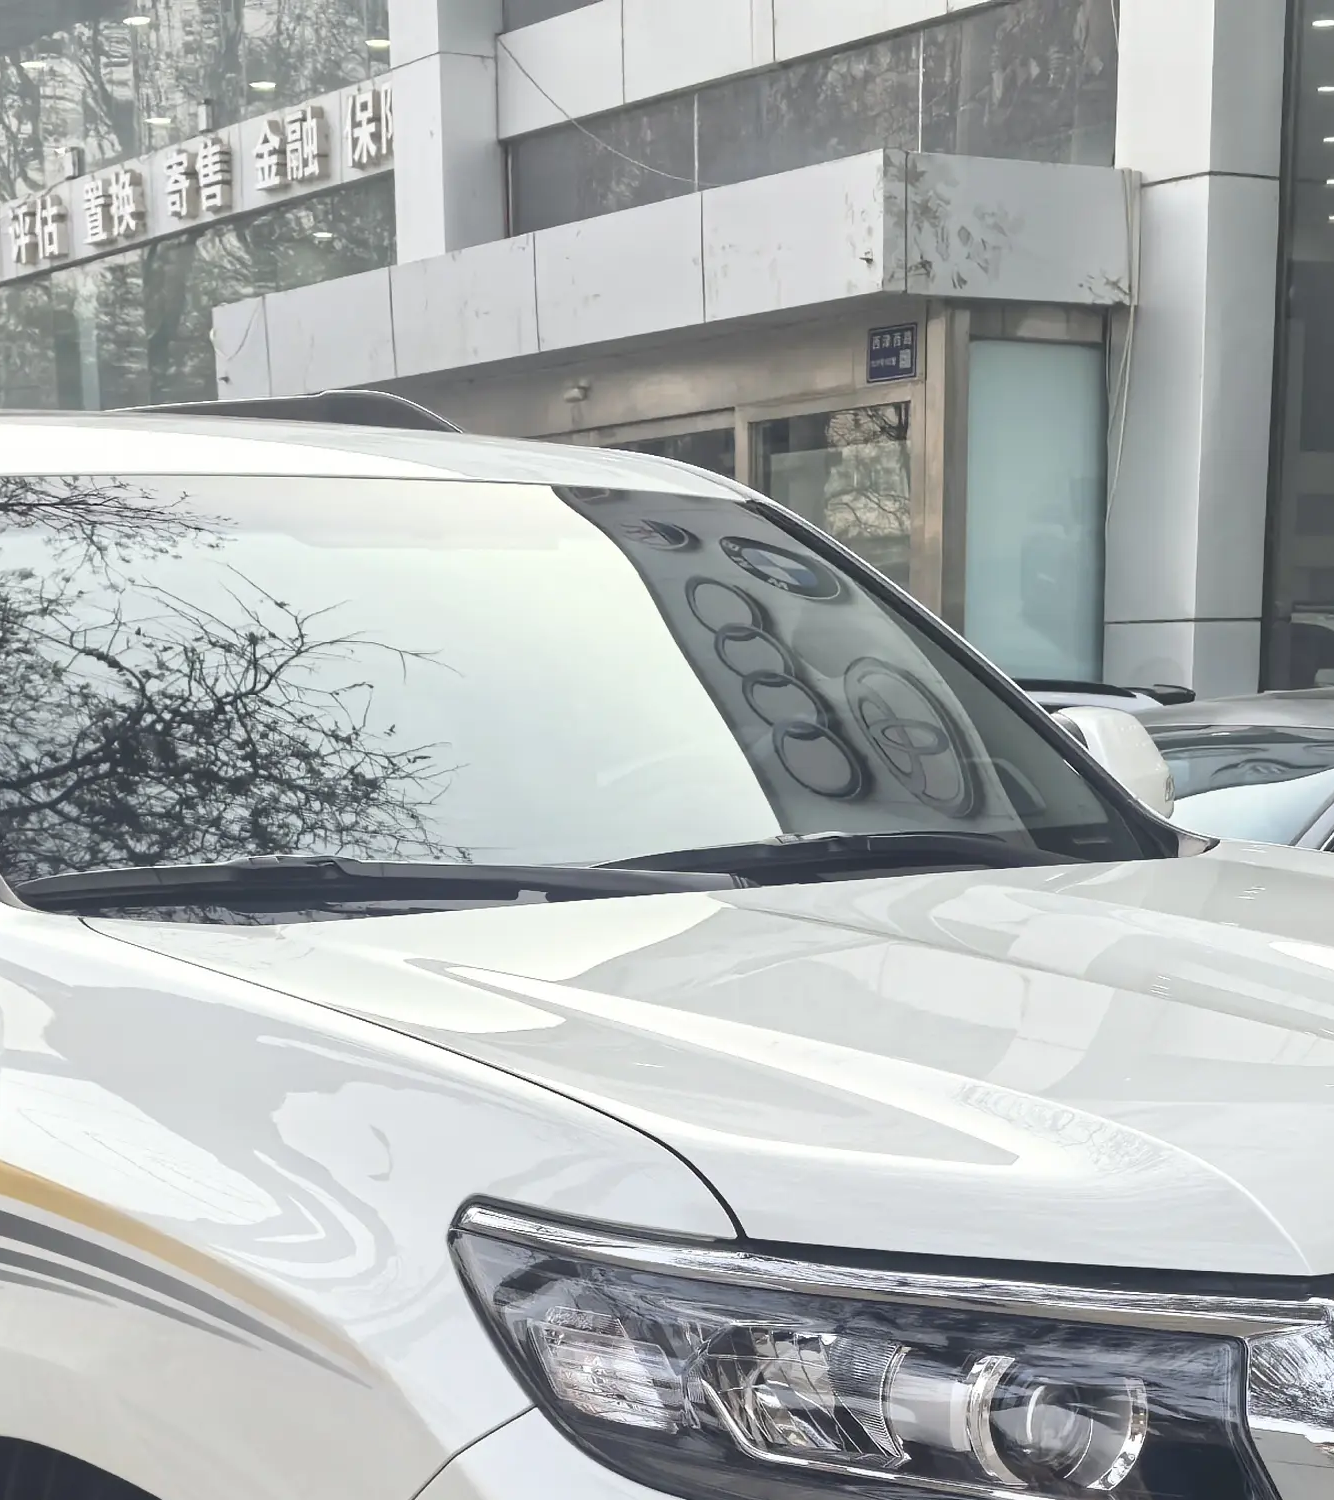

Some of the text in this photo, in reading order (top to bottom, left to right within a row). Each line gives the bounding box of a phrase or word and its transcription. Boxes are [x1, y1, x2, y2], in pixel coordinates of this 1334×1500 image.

[8, 195, 59, 264] 评估
[83, 169, 137, 244] 置换
[166, 138, 225, 216] 寄售
[255, 106, 320, 190] 金融
